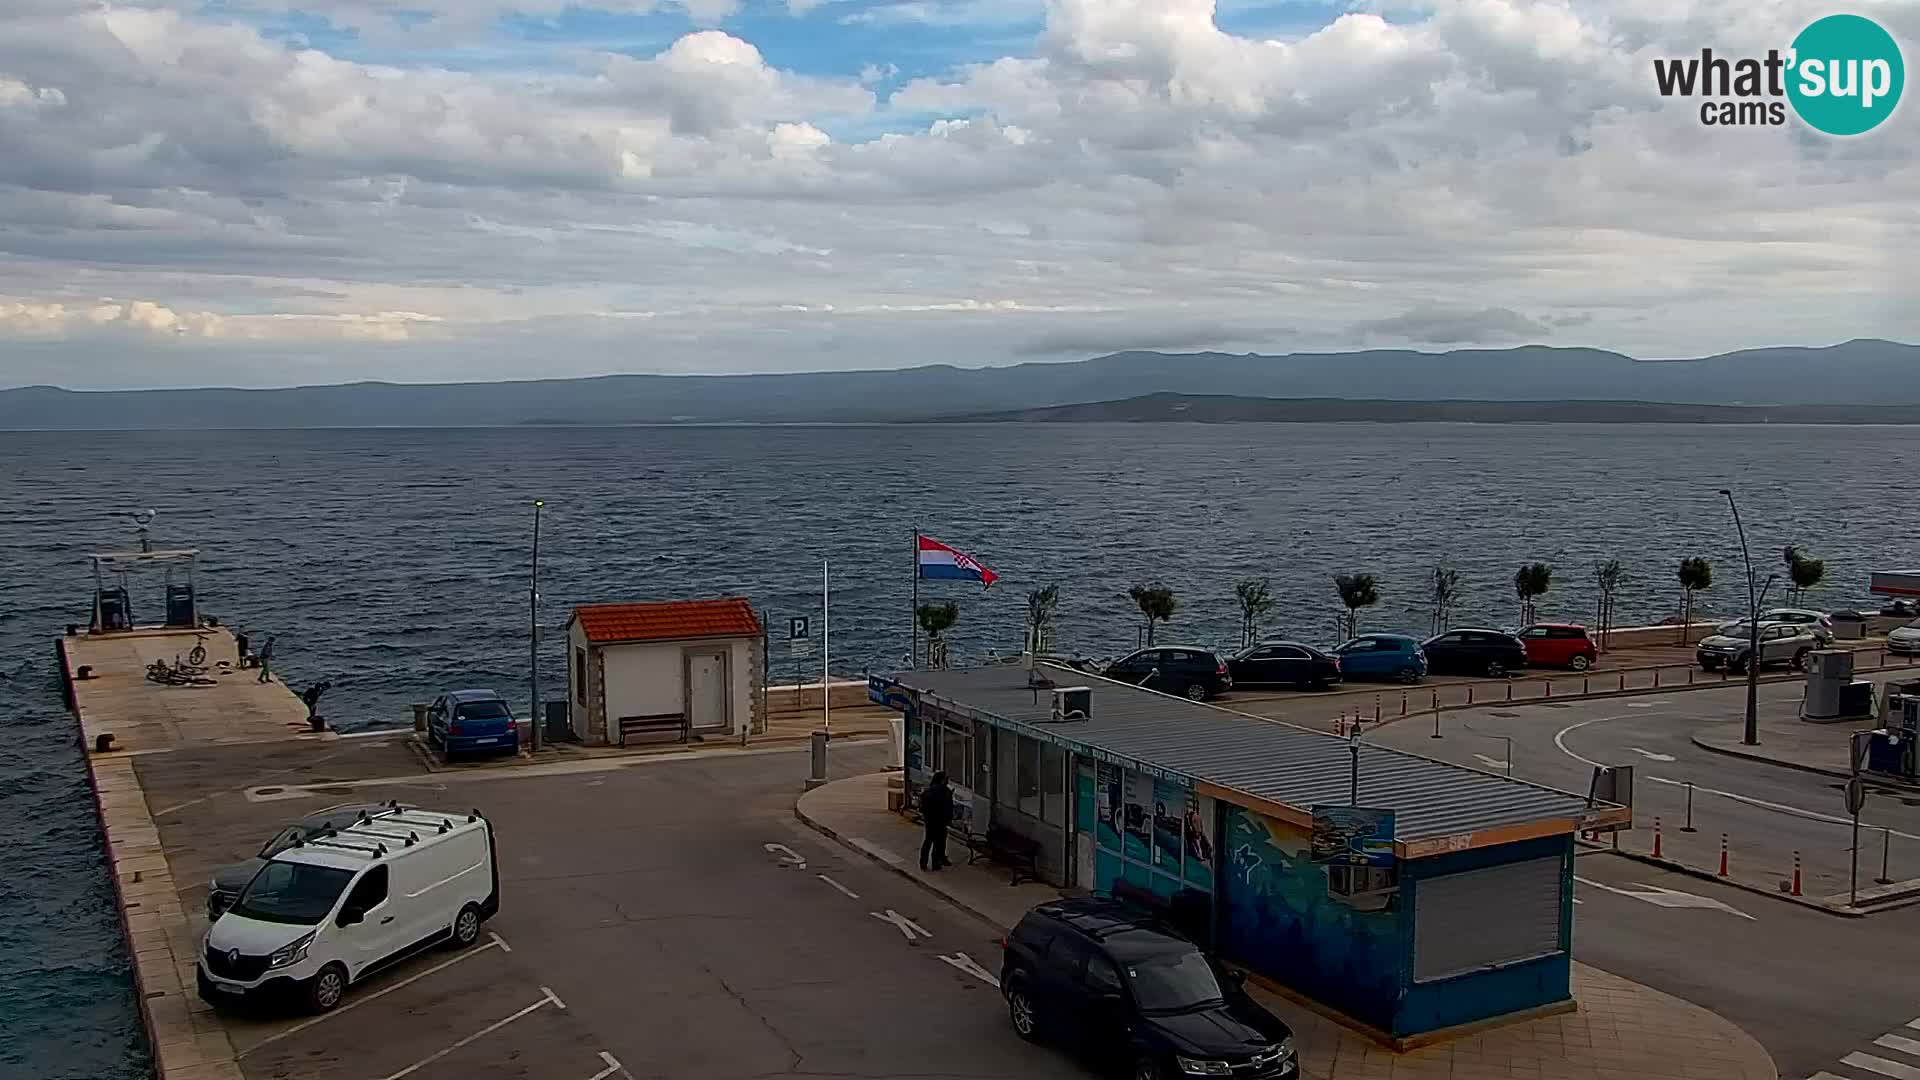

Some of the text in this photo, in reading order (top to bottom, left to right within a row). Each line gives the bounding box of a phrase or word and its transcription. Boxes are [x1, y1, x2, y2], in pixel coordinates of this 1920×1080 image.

[794, 620, 804, 636] P
[1092, 749, 1106, 760] BUS
[1107, 753, 1136, 769] STATION
